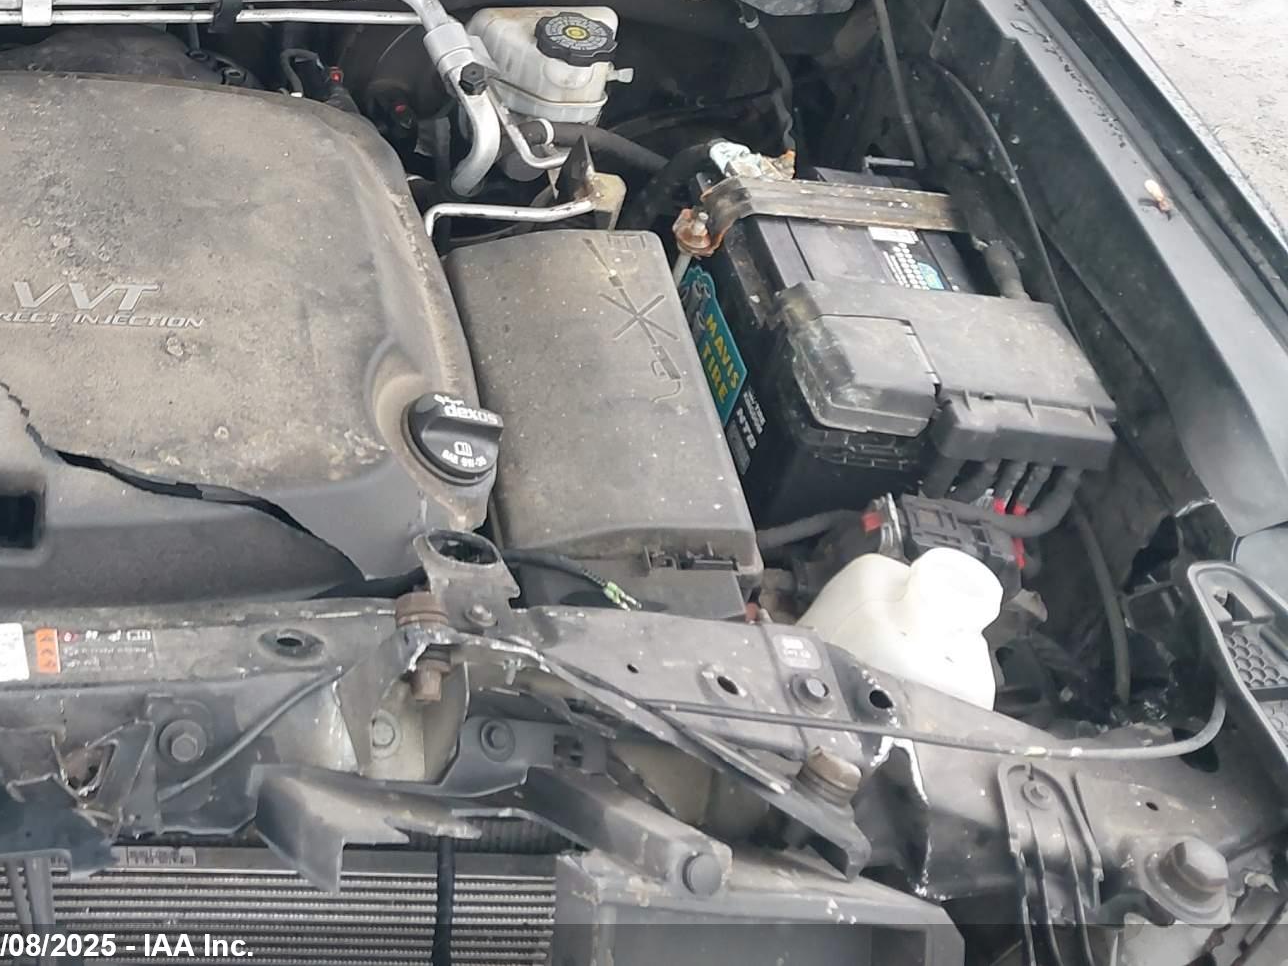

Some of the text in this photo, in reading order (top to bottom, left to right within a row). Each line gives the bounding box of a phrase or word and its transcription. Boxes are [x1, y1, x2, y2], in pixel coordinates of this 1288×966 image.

[13, 281, 161, 311] VVT
[72, 312, 204, 329] INJECTION
[706, 313, 739, 388] MAVIS
[702, 341, 728, 404] TIRE
[445, 404, 498, 424] dexos
